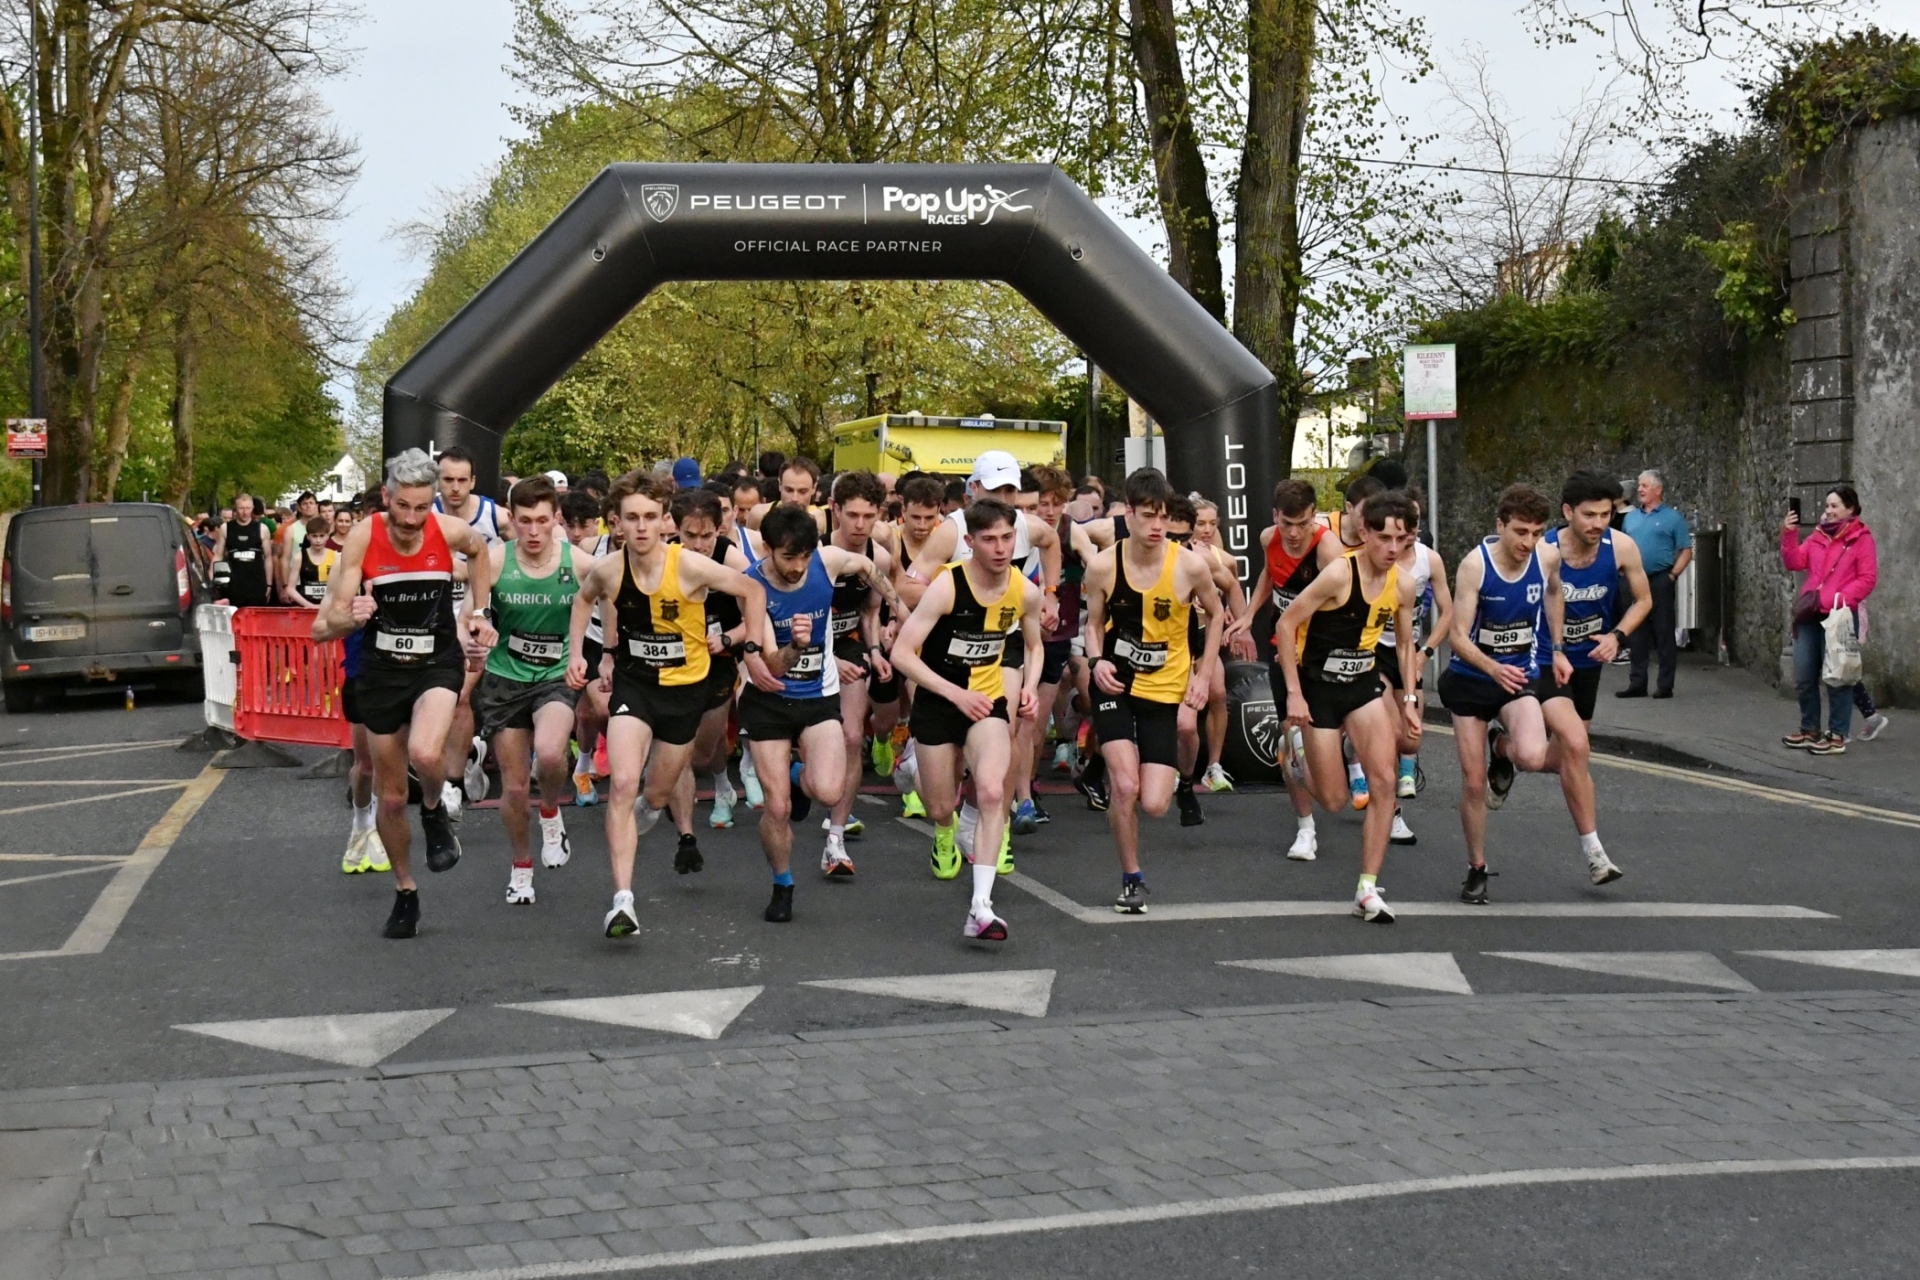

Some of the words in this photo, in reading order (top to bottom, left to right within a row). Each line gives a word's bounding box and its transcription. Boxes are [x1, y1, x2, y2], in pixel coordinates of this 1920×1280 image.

[690, 195, 847, 210] PEUGEOT
[883, 186, 941, 220] Pop
[945, 187, 987, 220] Up
[928, 214, 968, 225] RACES
[734, 240, 811, 252] OFFICIAL
[816, 240, 860, 252] RACE
[866, 240, 942, 252] PARTNER
[960, 420, 994, 428] AMBULANCE
[940, 457, 1036, 467] AMBCE
[312, 586, 325, 594] 569
[1562, 583, 1608, 602] Drake
[382, 594, 396, 602] An
[498, 592, 552, 605] CARRICK
[831, 621, 847, 632] 39
[1493, 631, 1518, 644] 969
[395, 638, 414, 650] 60
[522, 642, 548, 655] 575
[965, 643, 990, 655] 779
[642, 644, 669, 657] 384
[1129, 646, 1152, 663] 770
[1339, 661, 1363, 672] 330
[1099, 701, 1117, 711] KCH
[1247, 705, 1277, 713] PEUG
